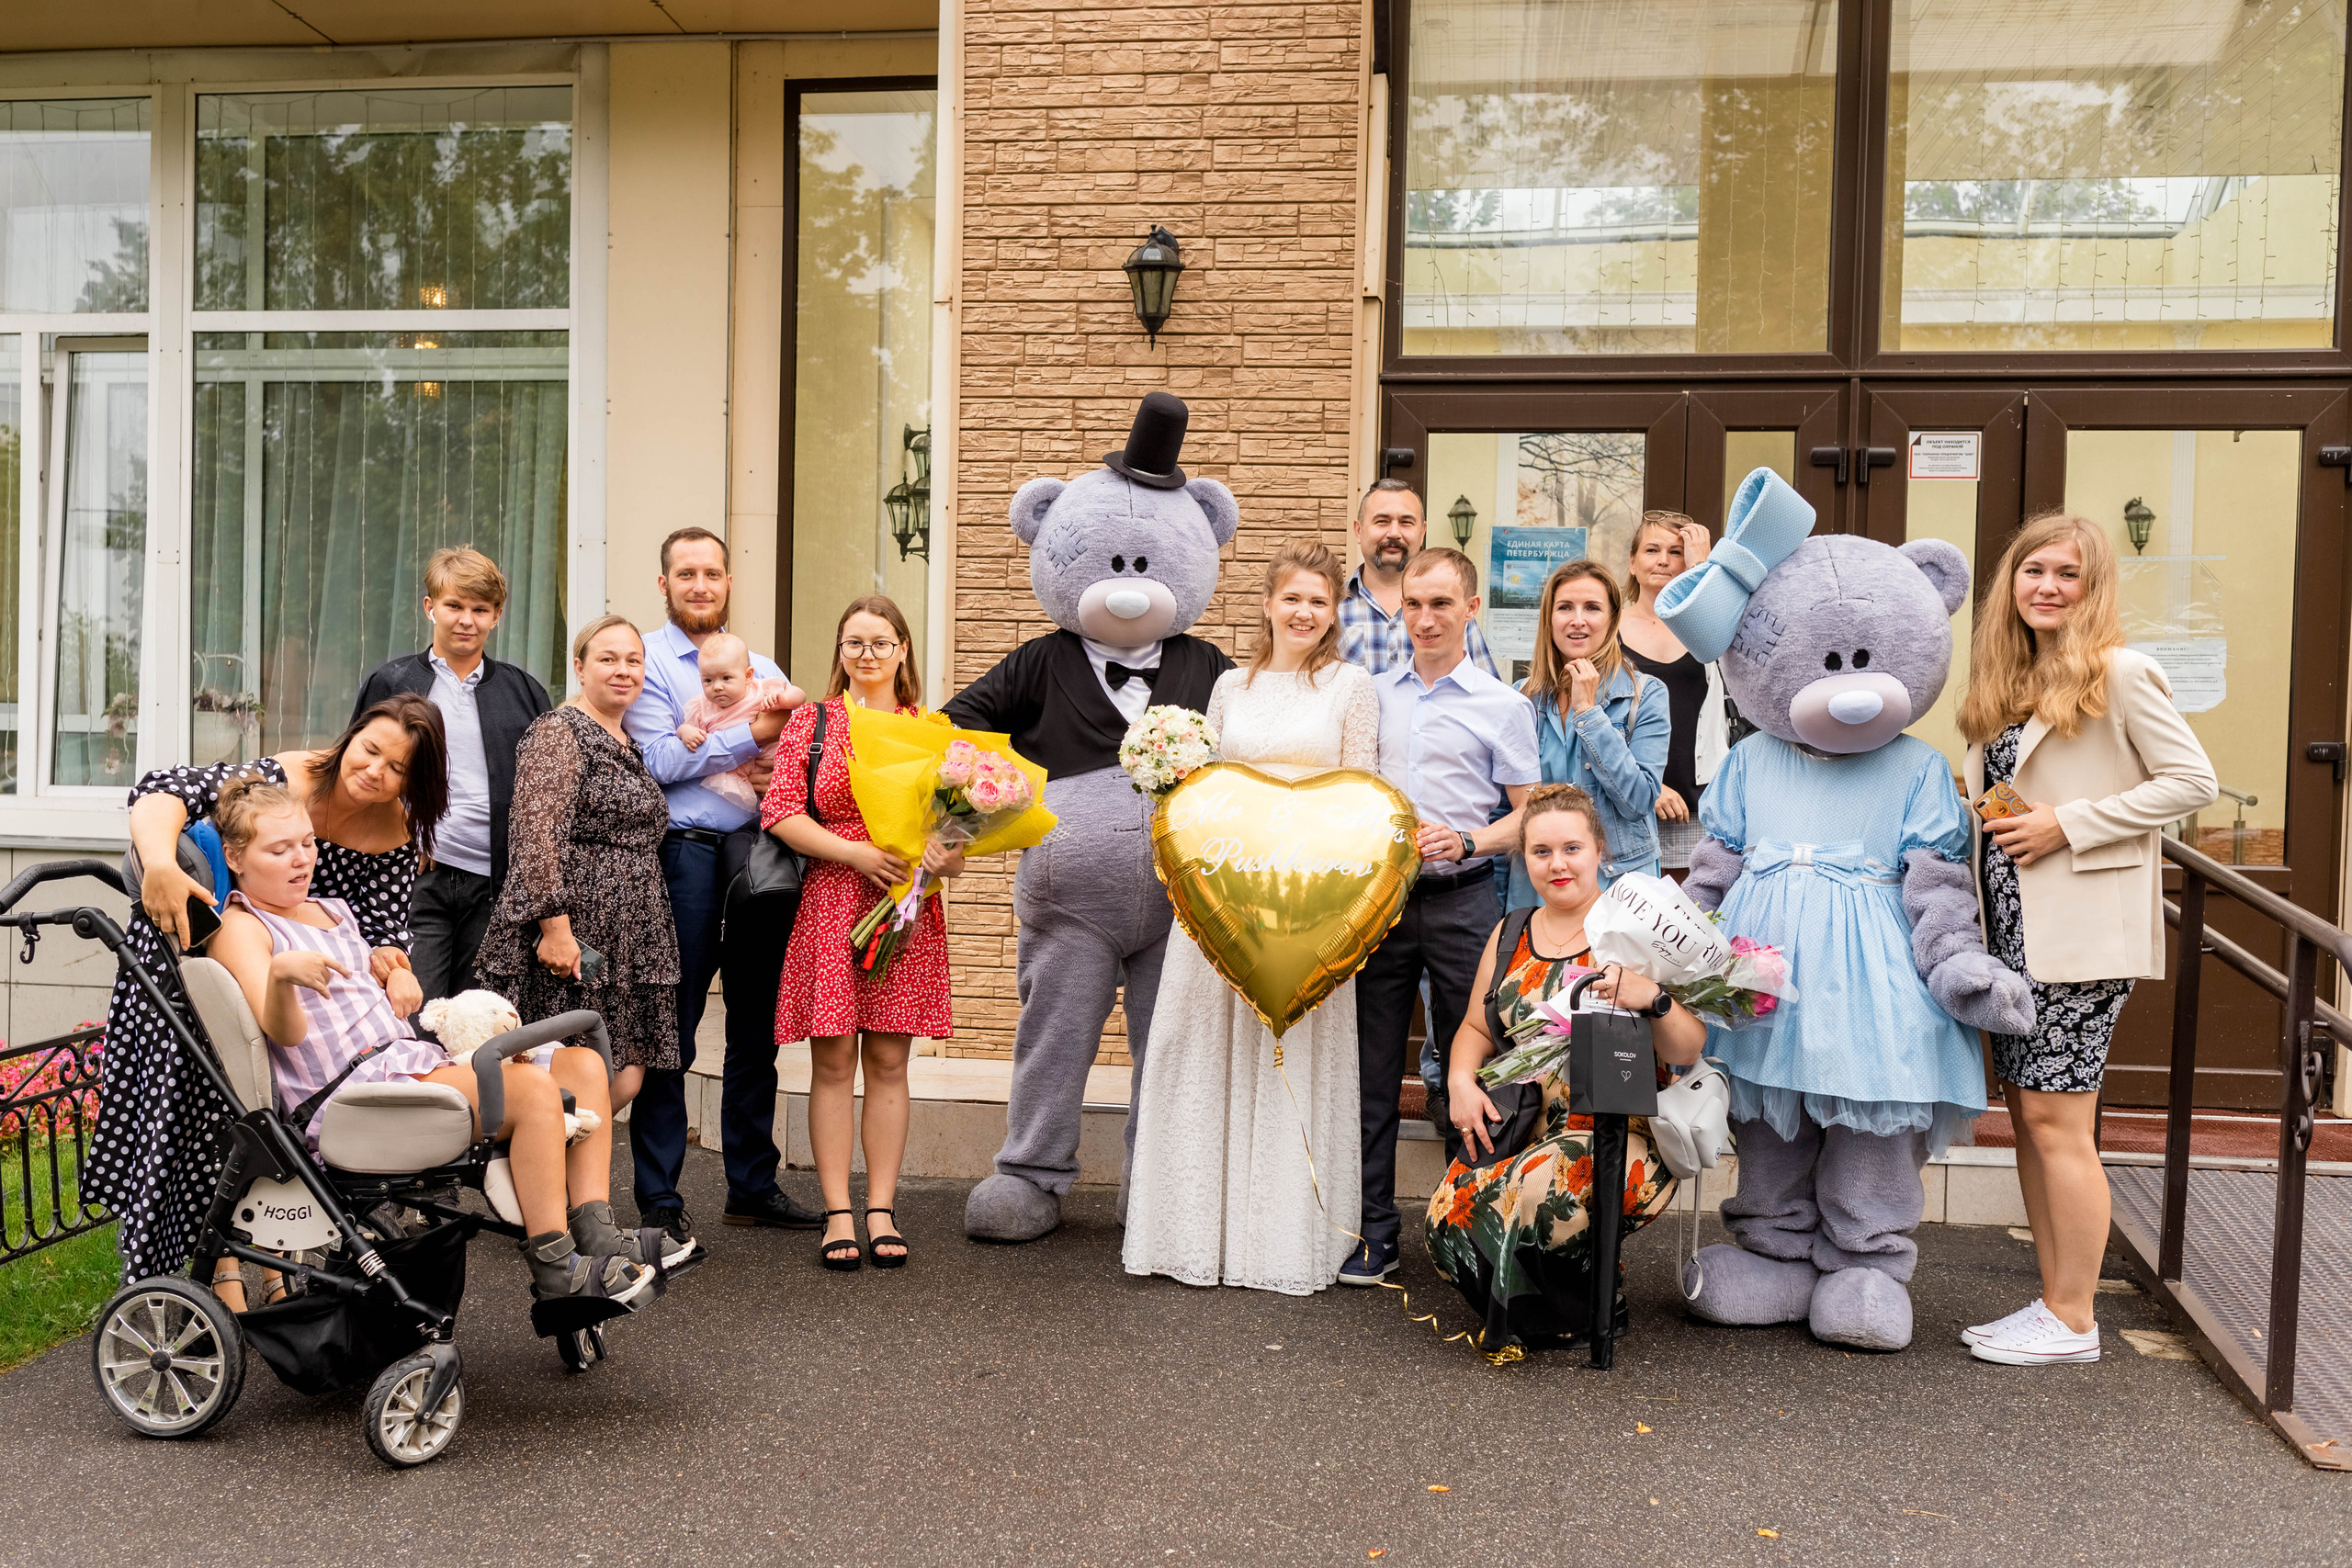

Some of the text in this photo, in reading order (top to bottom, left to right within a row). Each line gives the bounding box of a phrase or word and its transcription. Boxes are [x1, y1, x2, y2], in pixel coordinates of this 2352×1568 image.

[1507, 540, 1542, 548] ЕДИНАЯ
[1507, 549, 1570, 558] ПЕТЕРБУРЖЦА
[1171, 790, 1243, 830] Mr
[1324, 805, 1406, 843] Mrs
[1200, 837, 1374, 876] Pushkarev
[1650, 911, 1698, 954] YOU
[264, 1205, 312, 1221] HOGGI
